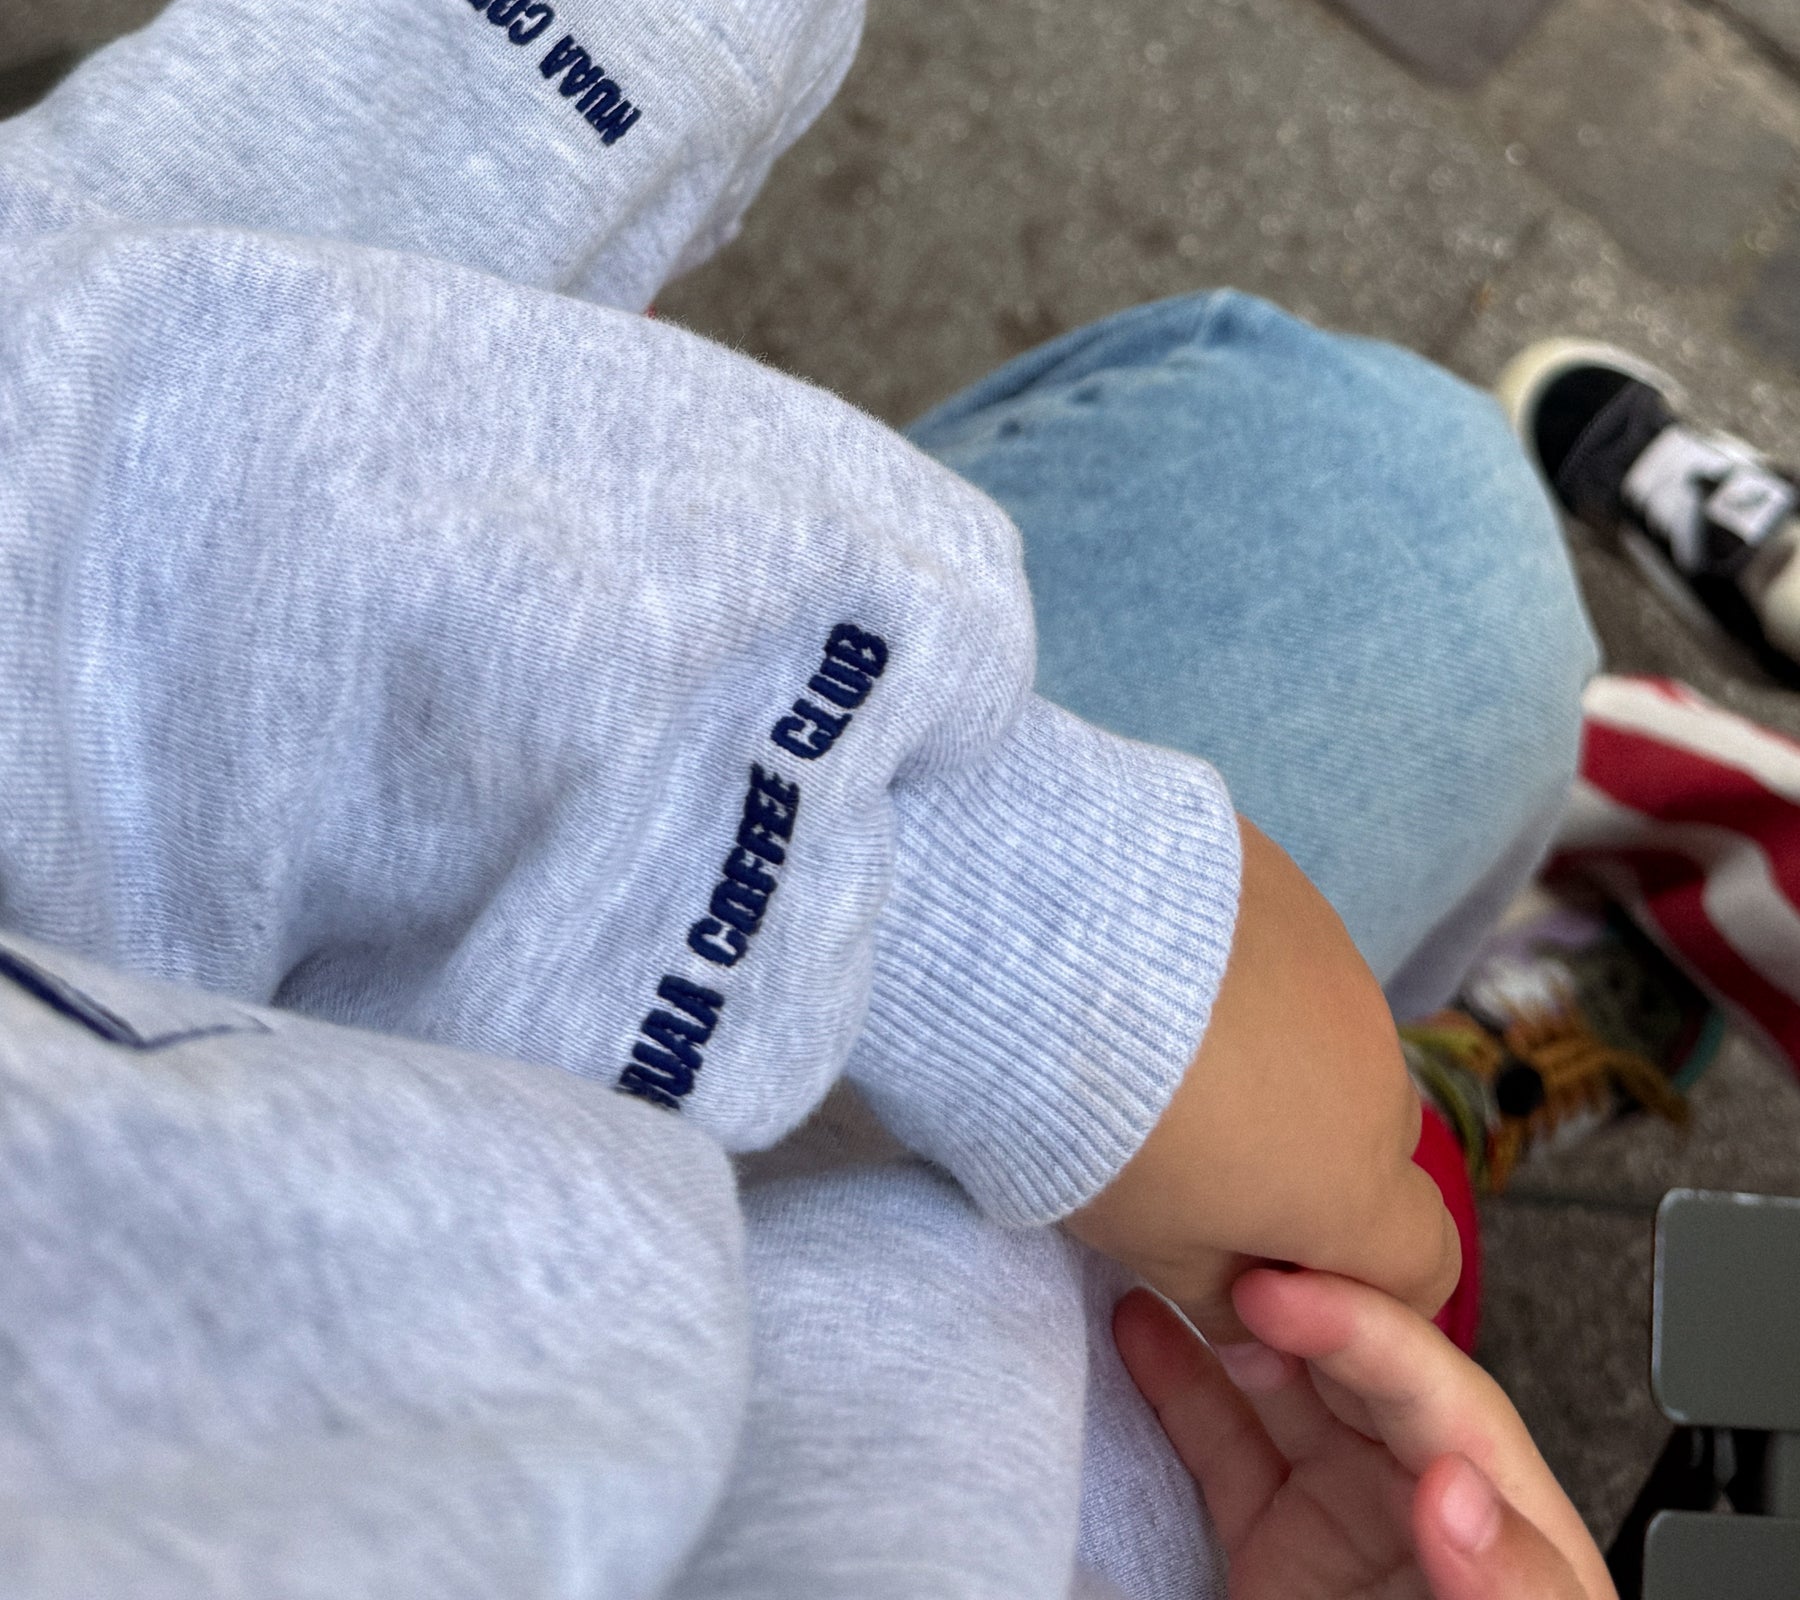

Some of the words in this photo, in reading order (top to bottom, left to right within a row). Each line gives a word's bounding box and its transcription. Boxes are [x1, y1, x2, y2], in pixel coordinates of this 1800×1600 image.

[538, 34, 642, 146] NUAA
[686, 762, 800, 967] COFFEE
[770, 622, 890, 761] CLUB
